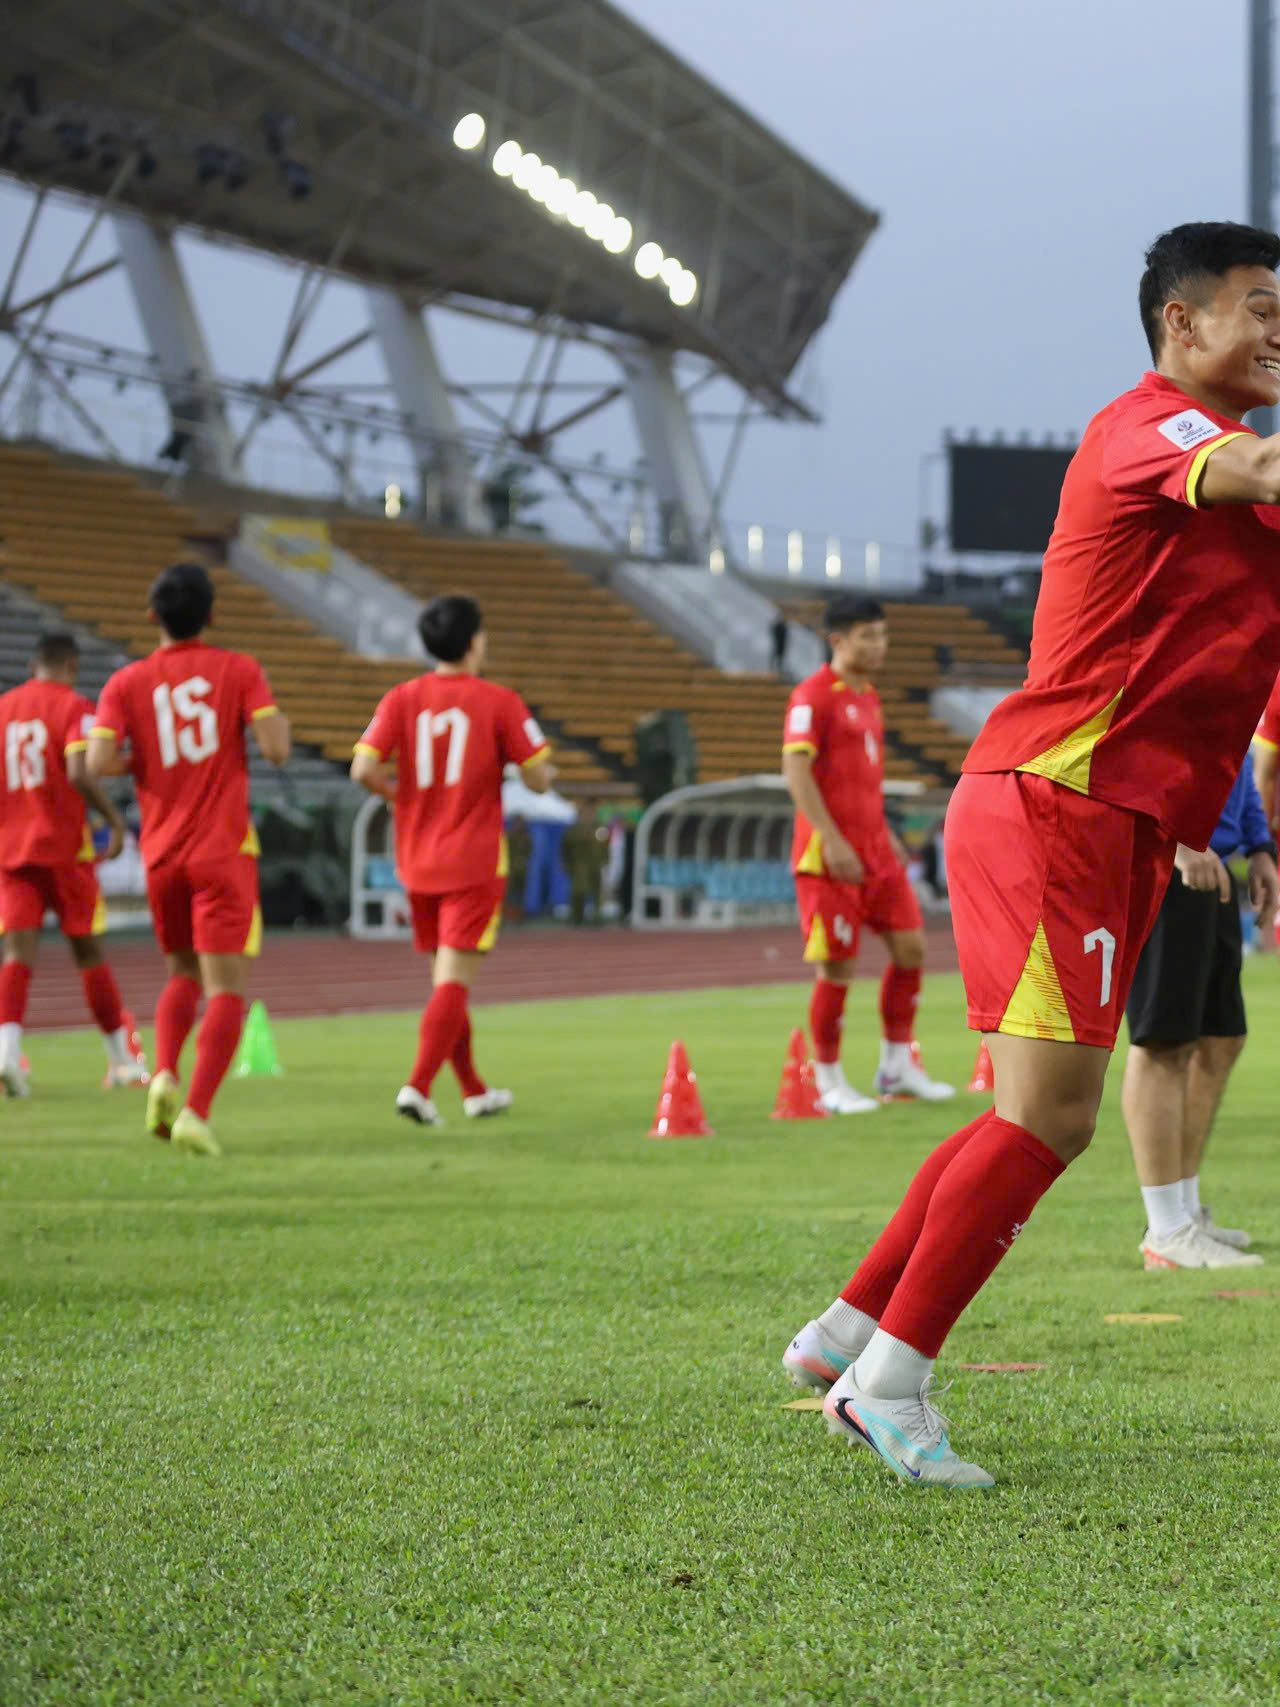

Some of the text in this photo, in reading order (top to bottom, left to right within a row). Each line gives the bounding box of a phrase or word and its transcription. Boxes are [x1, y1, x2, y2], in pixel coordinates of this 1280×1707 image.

[6, 718, 47, 791] 13
[153, 675, 219, 768] 15
[416, 706, 470, 788] 17
[1083, 926, 1116, 1007] 7
